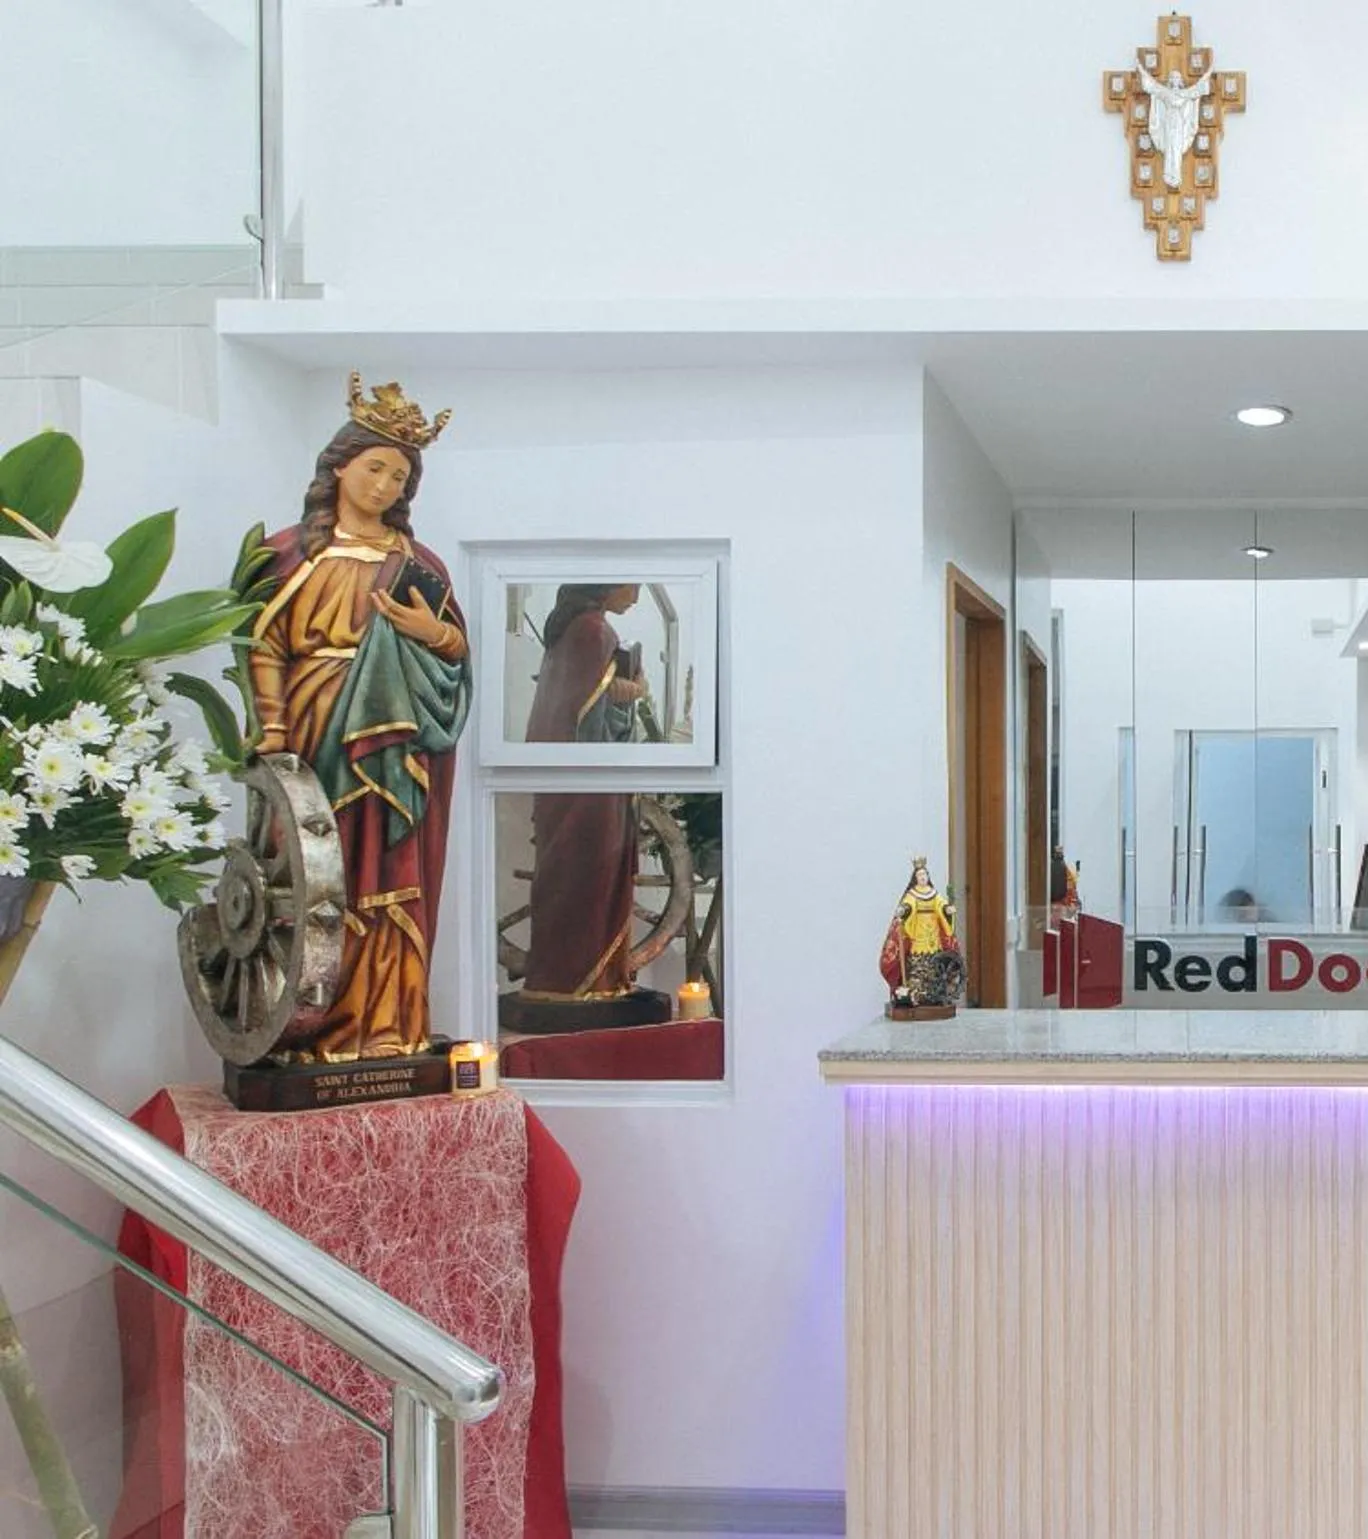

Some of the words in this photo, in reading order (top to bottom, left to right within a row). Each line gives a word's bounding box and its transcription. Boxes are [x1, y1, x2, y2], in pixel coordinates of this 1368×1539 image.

[315, 1074, 348, 1086] SAINT
[353, 1068, 416, 1082] CATHERINE
[336, 1082, 412, 1098] ALEXANDRIA
